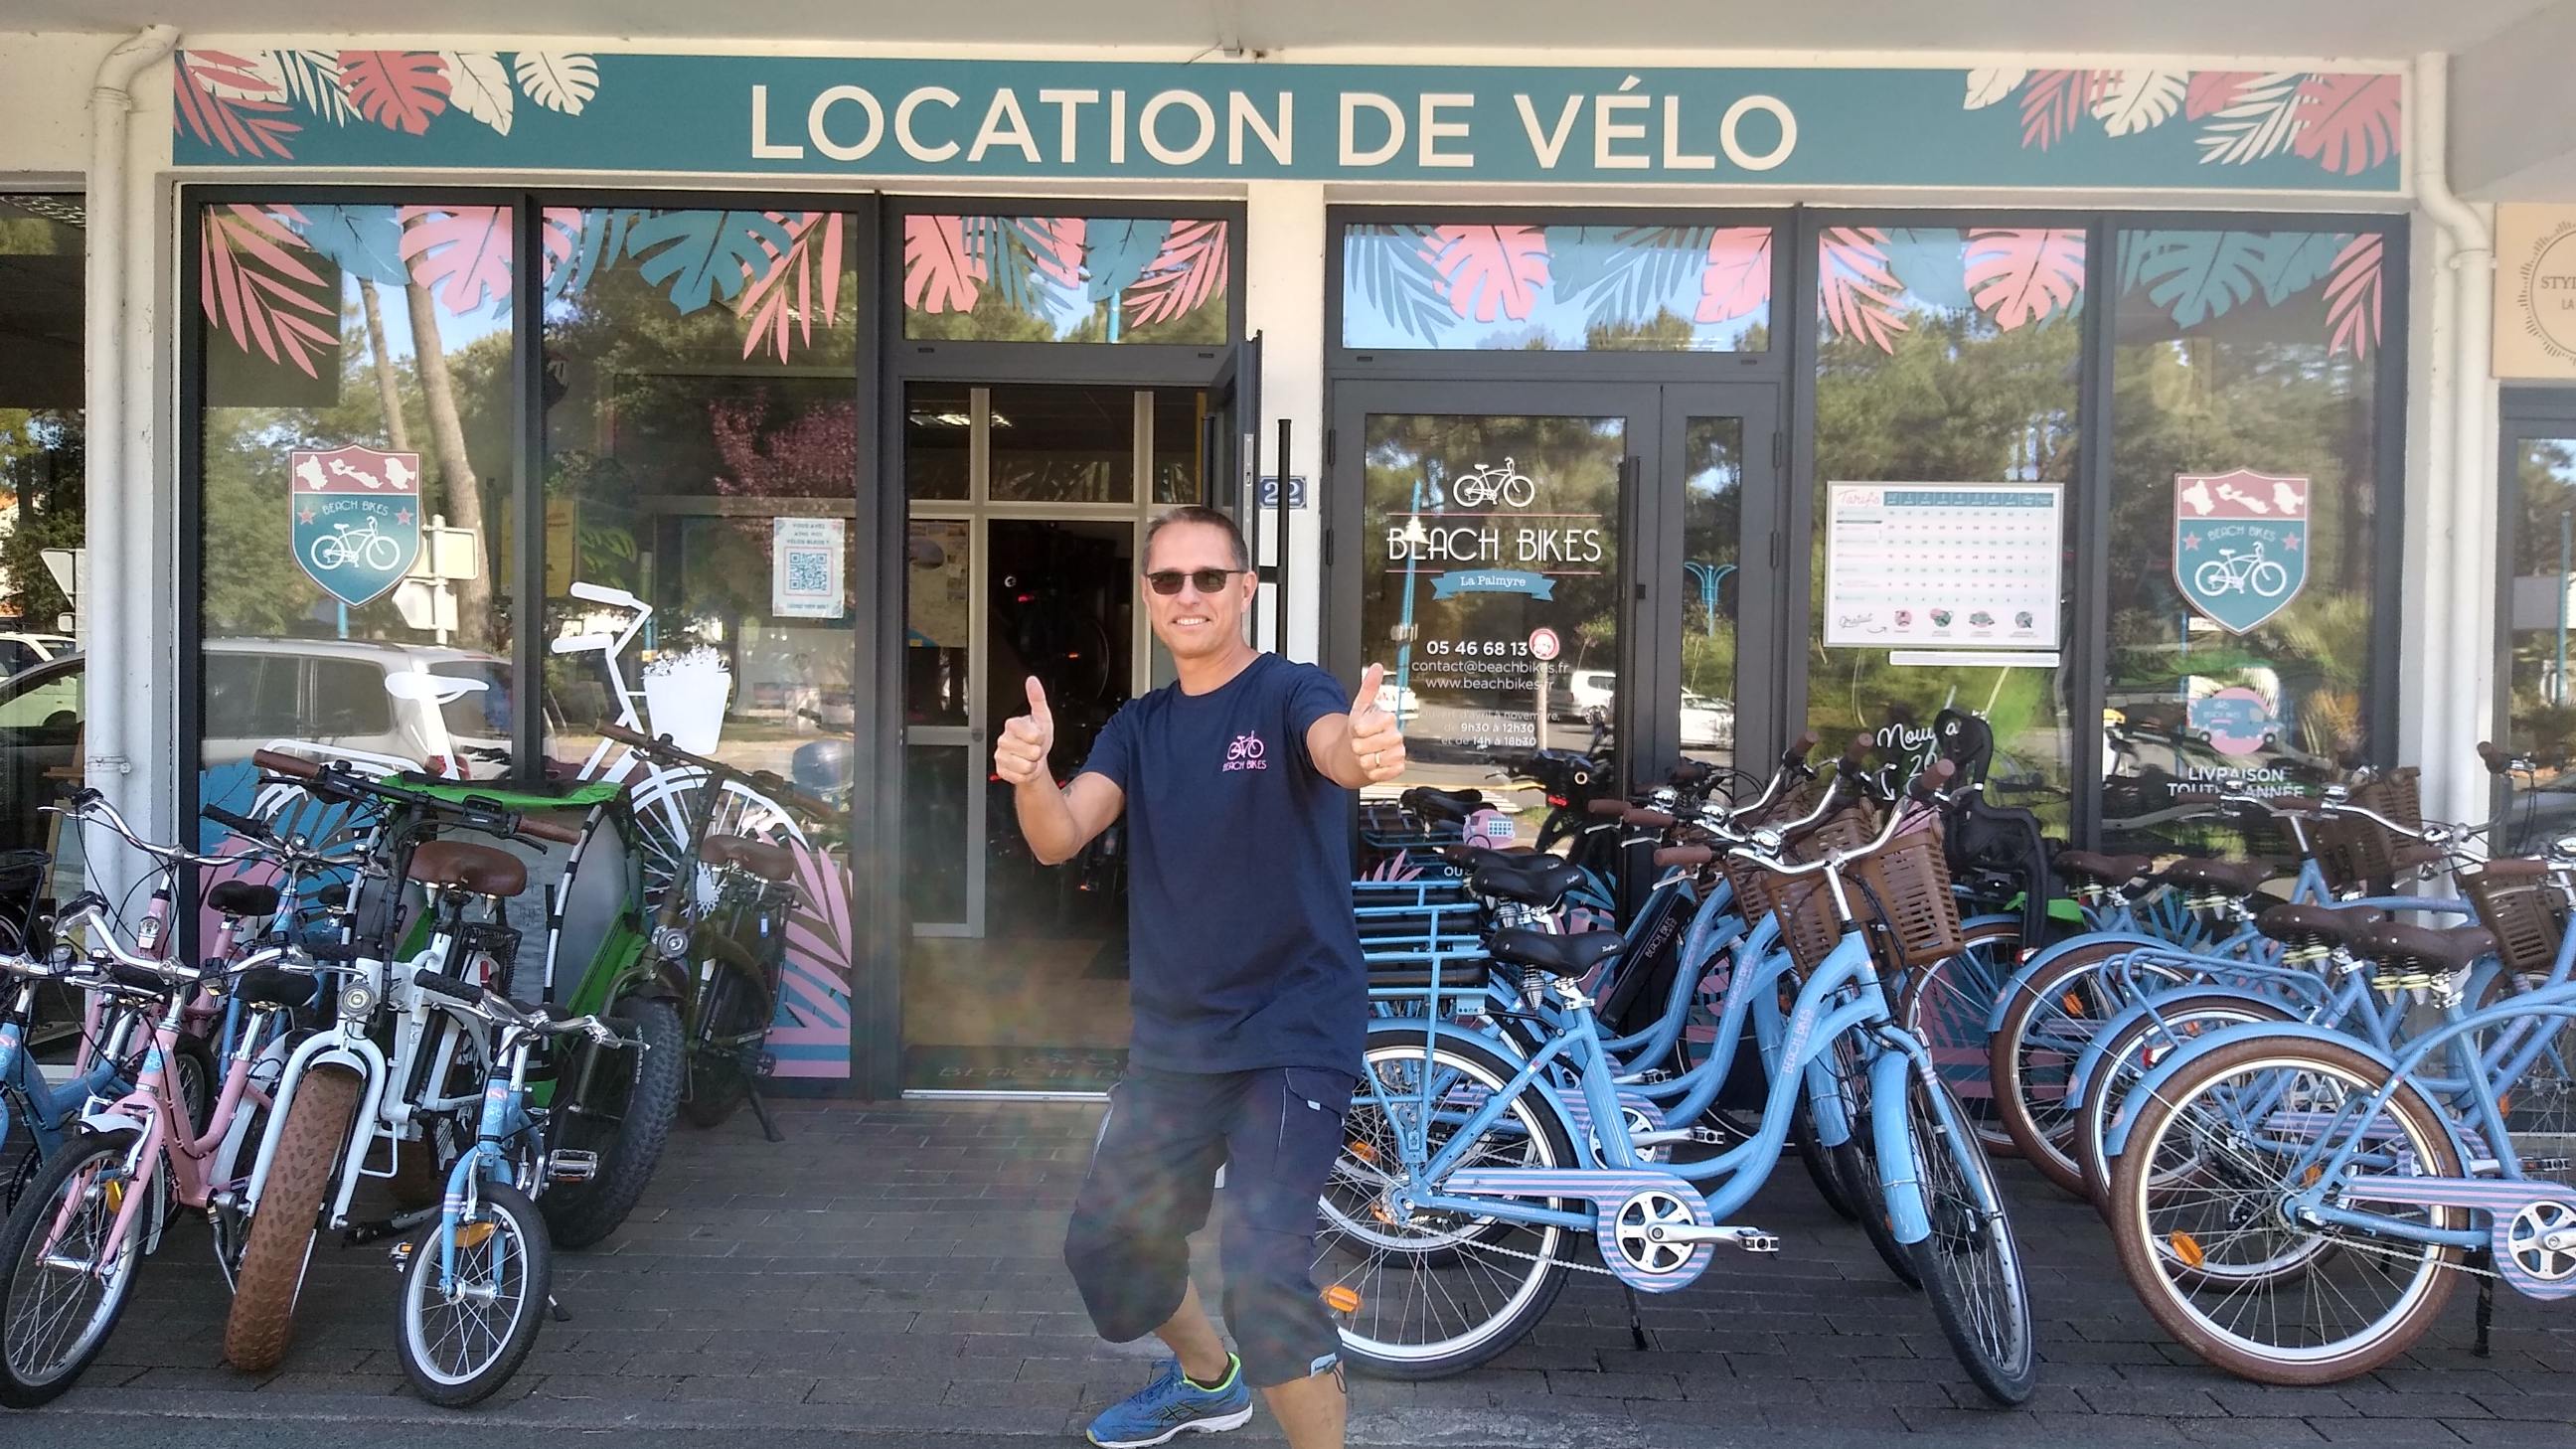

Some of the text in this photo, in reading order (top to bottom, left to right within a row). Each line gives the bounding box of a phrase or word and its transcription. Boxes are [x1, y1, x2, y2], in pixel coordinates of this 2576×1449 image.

[752, 76, 1798, 172] LOCATION DE VÉLO
[1263, 481, 1299, 504] 22
[322, 500, 389, 517] BEACH BIKES
[2208, 525, 2276, 543] BEACH BIKES
[1386, 527, 1602, 563] BEACH BIKES
[1459, 575, 1527, 588] La Palmyre
[1426, 641, 1529, 656] 05 46 68 13
[1411, 660, 1569, 675] contact@beachbiks.fr
[1425, 677, 1555, 691] www.beachbikesfr
[1503, 710, 1560, 722] novemre,
[1461, 723, 1489, 733] 9h30
[1492, 723, 1500, 732] à
[1503, 723, 1535, 733] 12h30
[1222, 759, 1267, 772] BEACH BIKES
